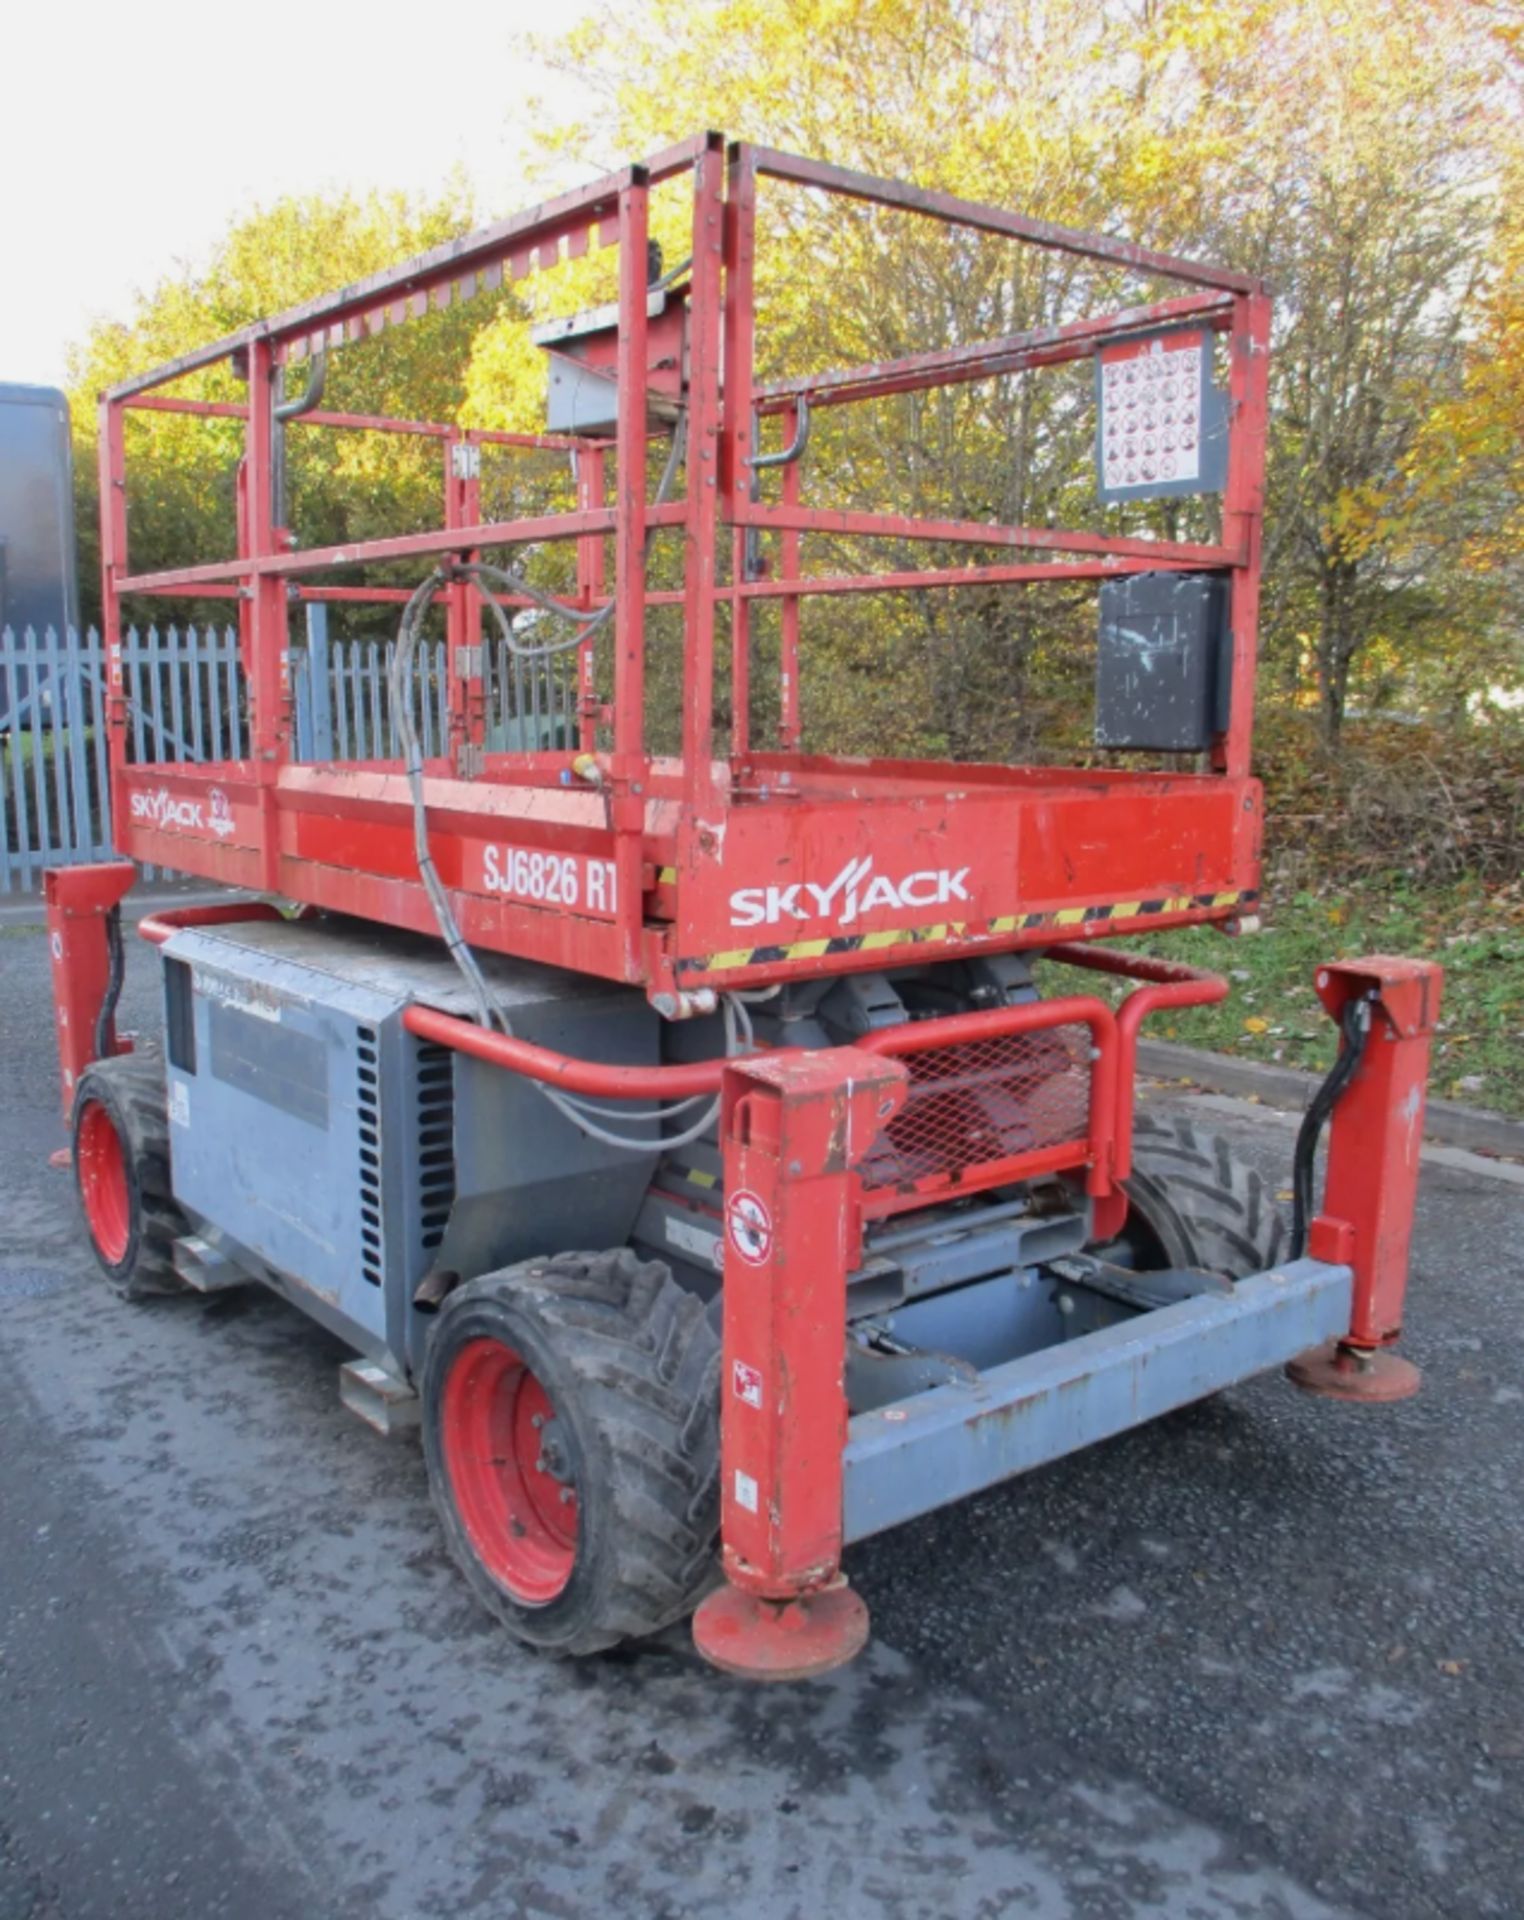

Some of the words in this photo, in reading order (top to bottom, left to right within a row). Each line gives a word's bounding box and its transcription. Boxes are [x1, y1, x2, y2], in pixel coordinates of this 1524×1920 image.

[131, 787, 204, 828] SKYJACK
[483, 844, 577, 905] SJ6826
[729, 855, 971, 926] SKYJACK
